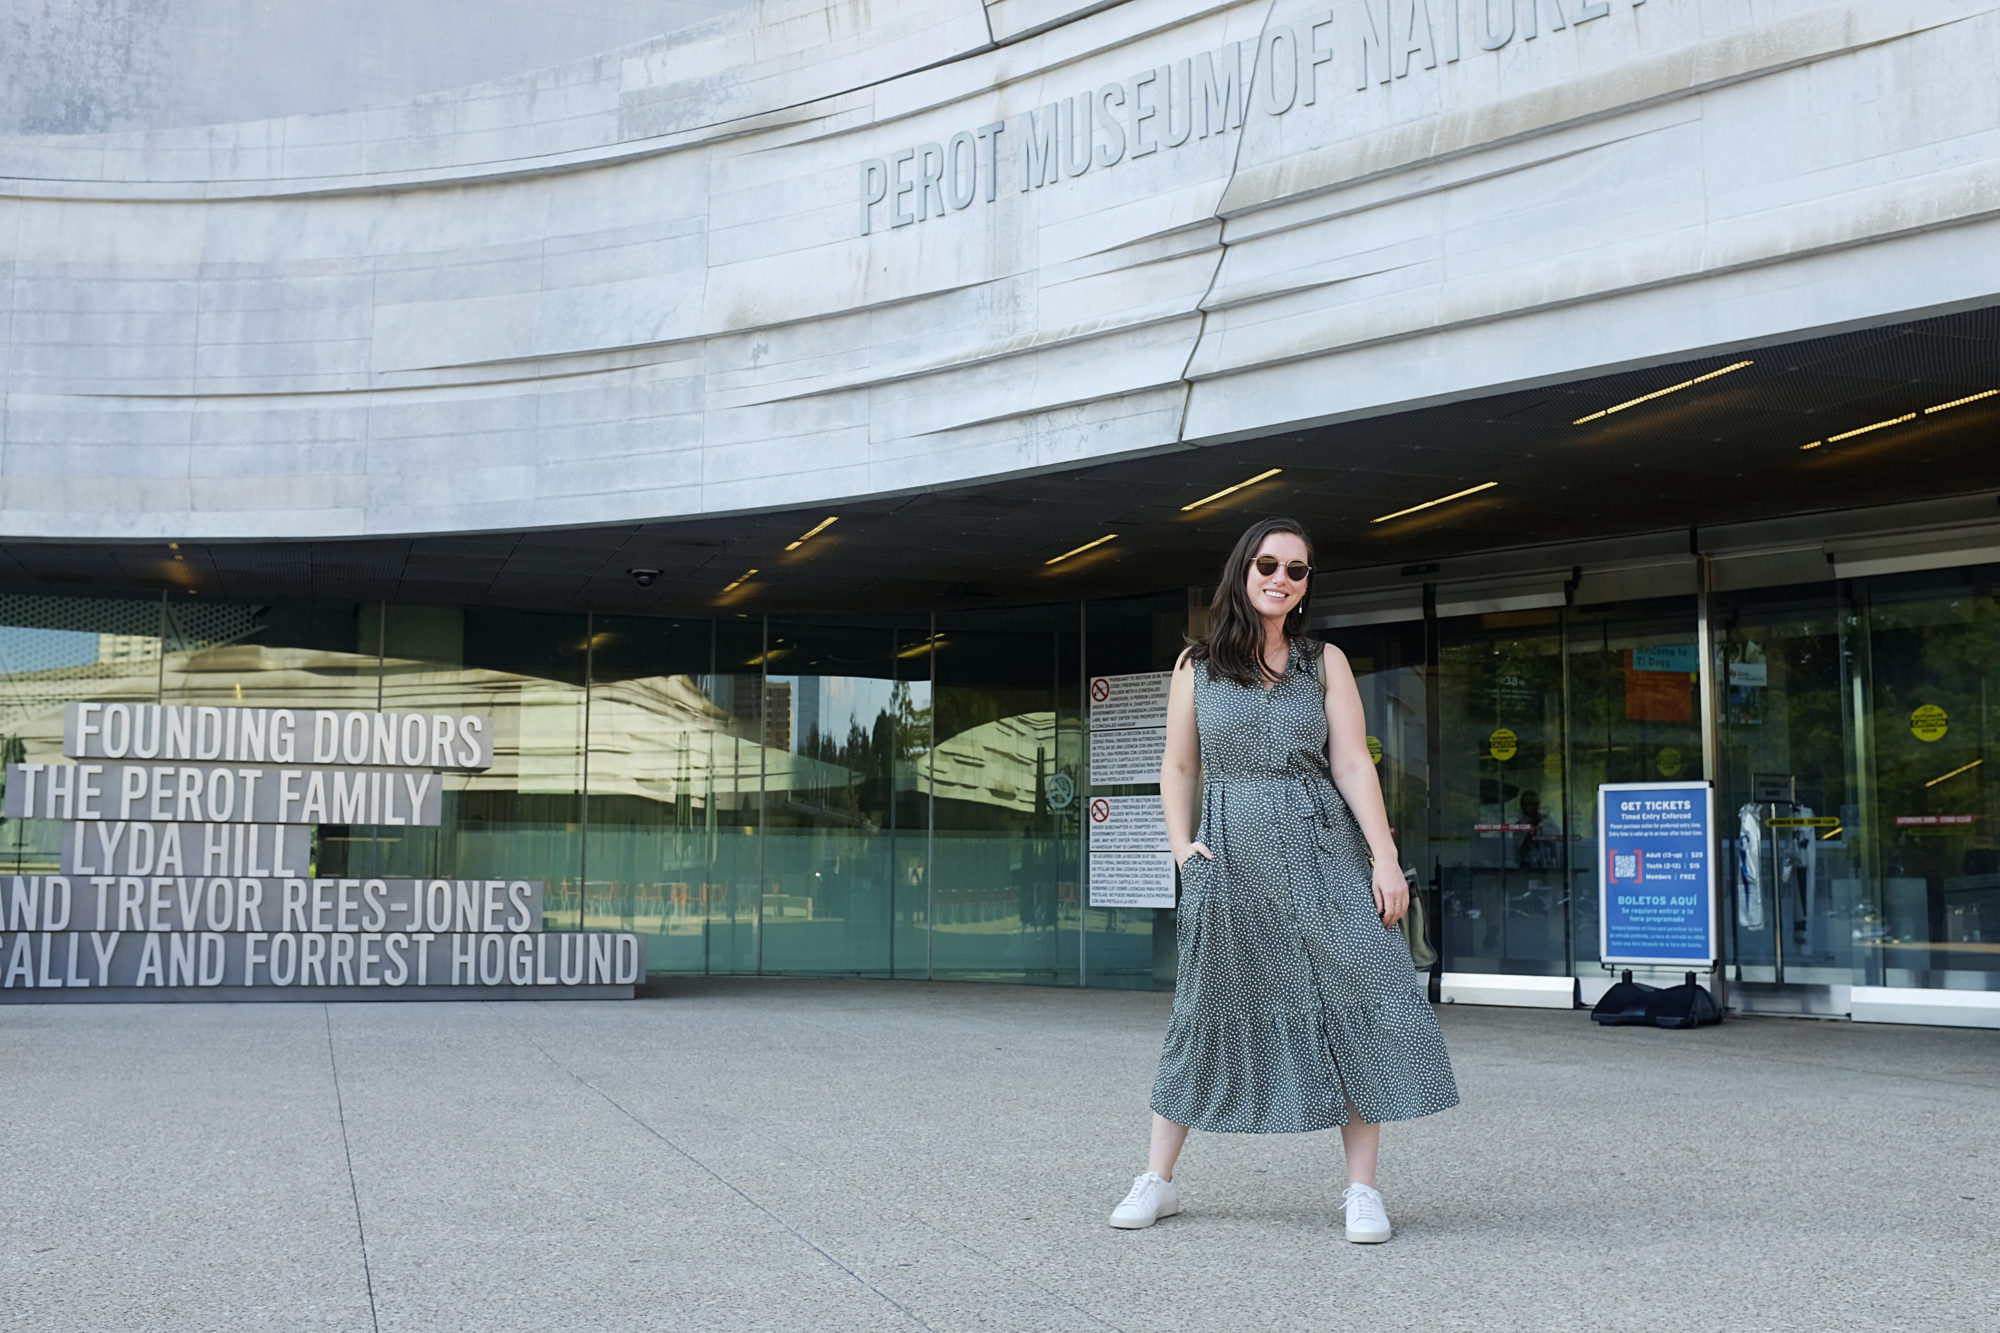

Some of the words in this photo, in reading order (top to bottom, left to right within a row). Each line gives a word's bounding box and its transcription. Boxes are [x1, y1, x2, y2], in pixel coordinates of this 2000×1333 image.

[858, 119, 1004, 236] PEROT
[1018, 41, 1241, 193] MUSEUM
[1263, 9, 1333, 116] OF
[1352, 0, 1609, 91] NATU
[1678, 647, 1687, 657] to
[76, 703, 295, 762] FOUNDING
[313, 711, 482, 767] DONORS
[18, 763, 103, 818] THE
[120, 766, 262, 822] PEROT
[279, 770, 431, 825] FAMILY
[1620, 802, 1642, 811] GET
[1645, 801, 1692, 810] TICKETS
[1642, 813, 1660, 822] Entry
[1662, 812, 1692, 820] Enforced
[73, 821, 183, 876] LYDA
[203, 823, 295, 877] HILL
[0, 876, 71, 931] ND
[90, 877, 262, 932] TREVOR
[282, 879, 531, 932] REES-JONES
[1618, 895, 1667, 905] BOLETOS
[1670, 893, 1697, 906] AQUÍ
[1645, 916, 1685, 924] programada
[0, 932, 120, 987] ALLY
[136, 933, 225, 986] AND
[245, 933, 435, 986] FORREST
[452, 934, 638, 986] HOGLUND
